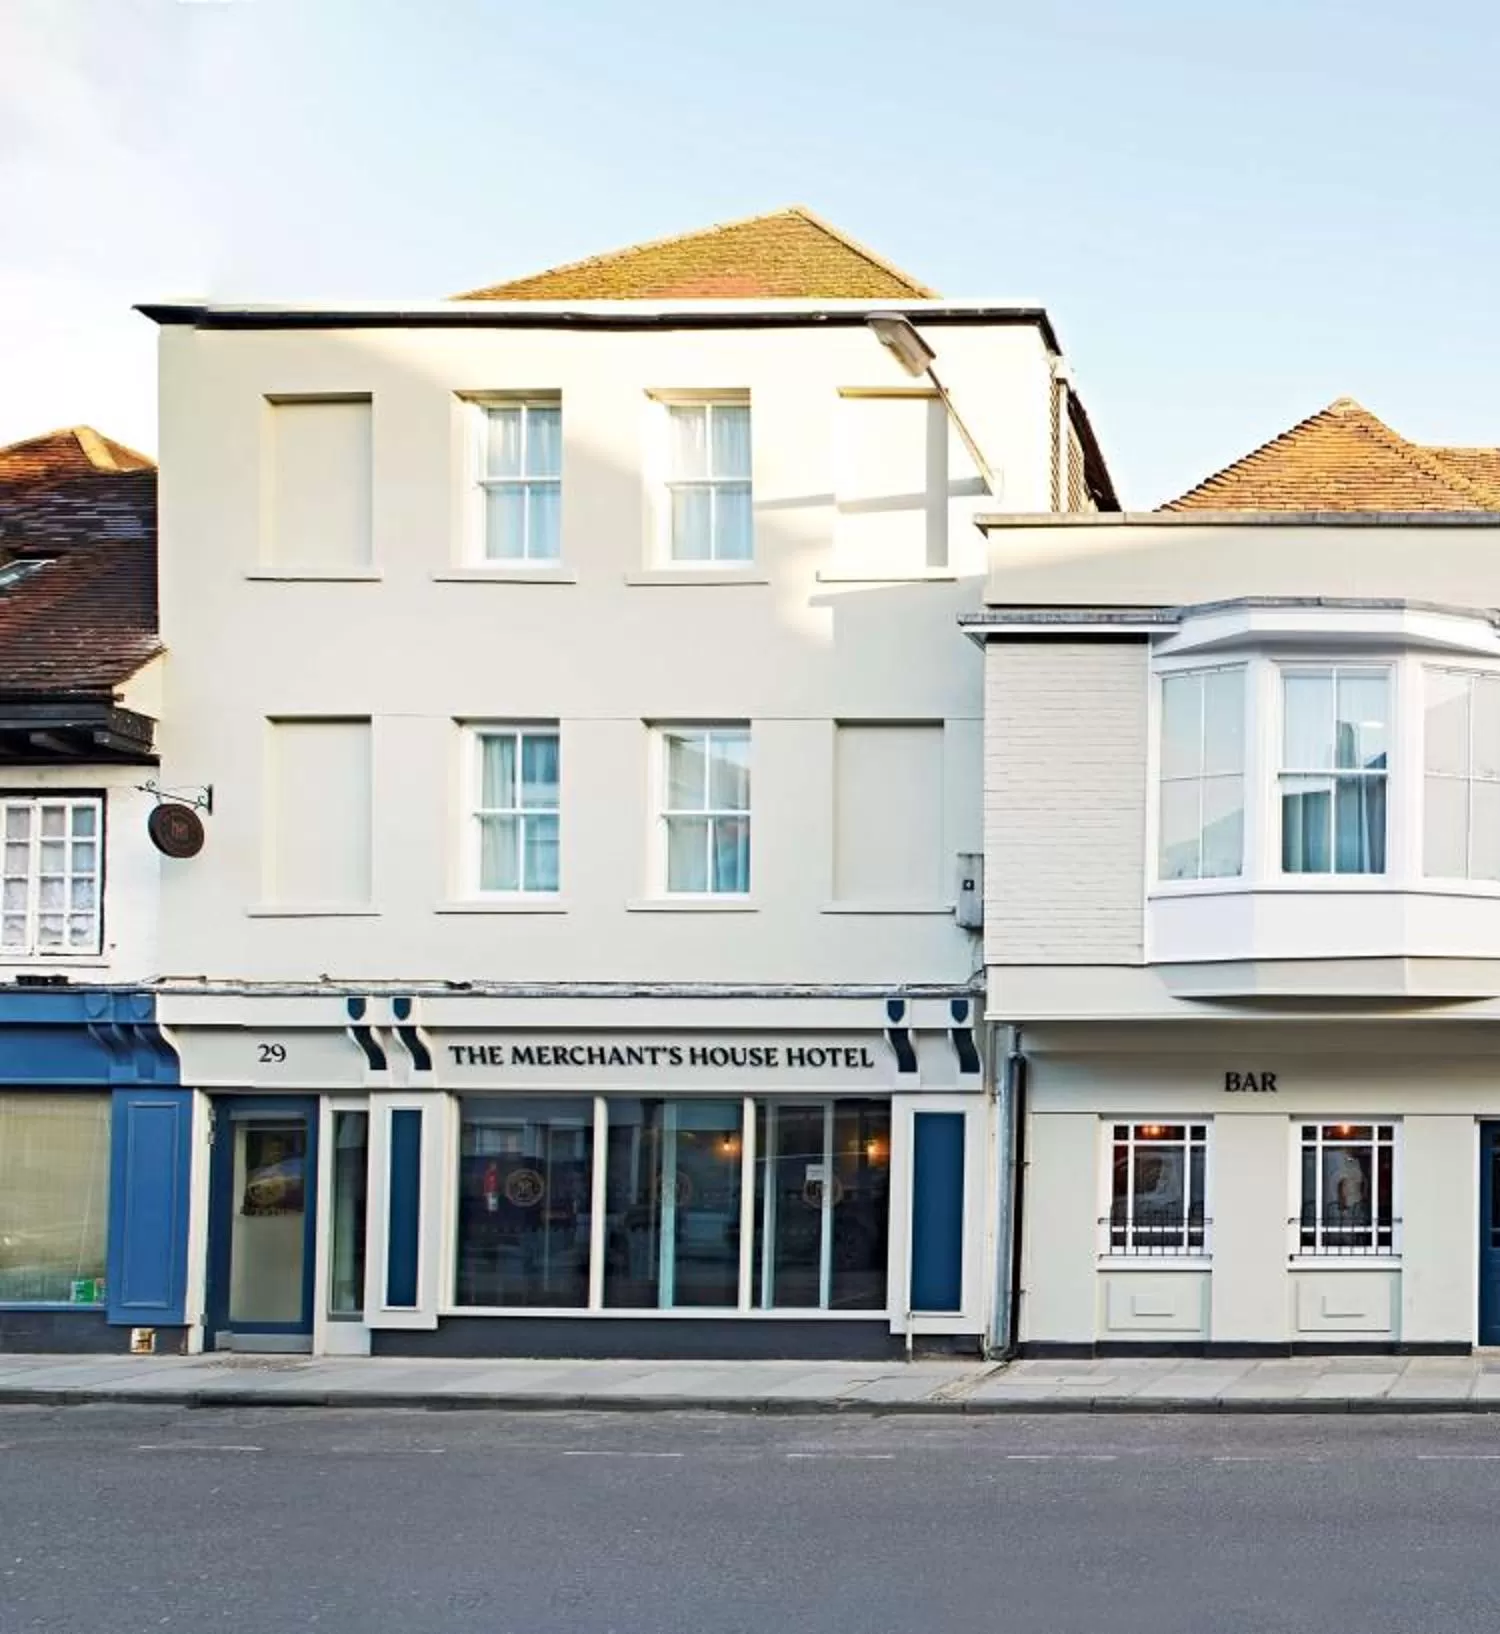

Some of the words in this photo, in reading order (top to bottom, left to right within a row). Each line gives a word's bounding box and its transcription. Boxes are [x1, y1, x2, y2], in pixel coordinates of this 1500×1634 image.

[258, 1043, 287, 1063] 29
[448, 1045, 504, 1066] THE
[511, 1045, 683, 1067] MERCHANT'S
[689, 1046, 779, 1068] HOUSE
[785, 1046, 875, 1069] HOTEL
[1224, 1070, 1278, 1093] BAR
